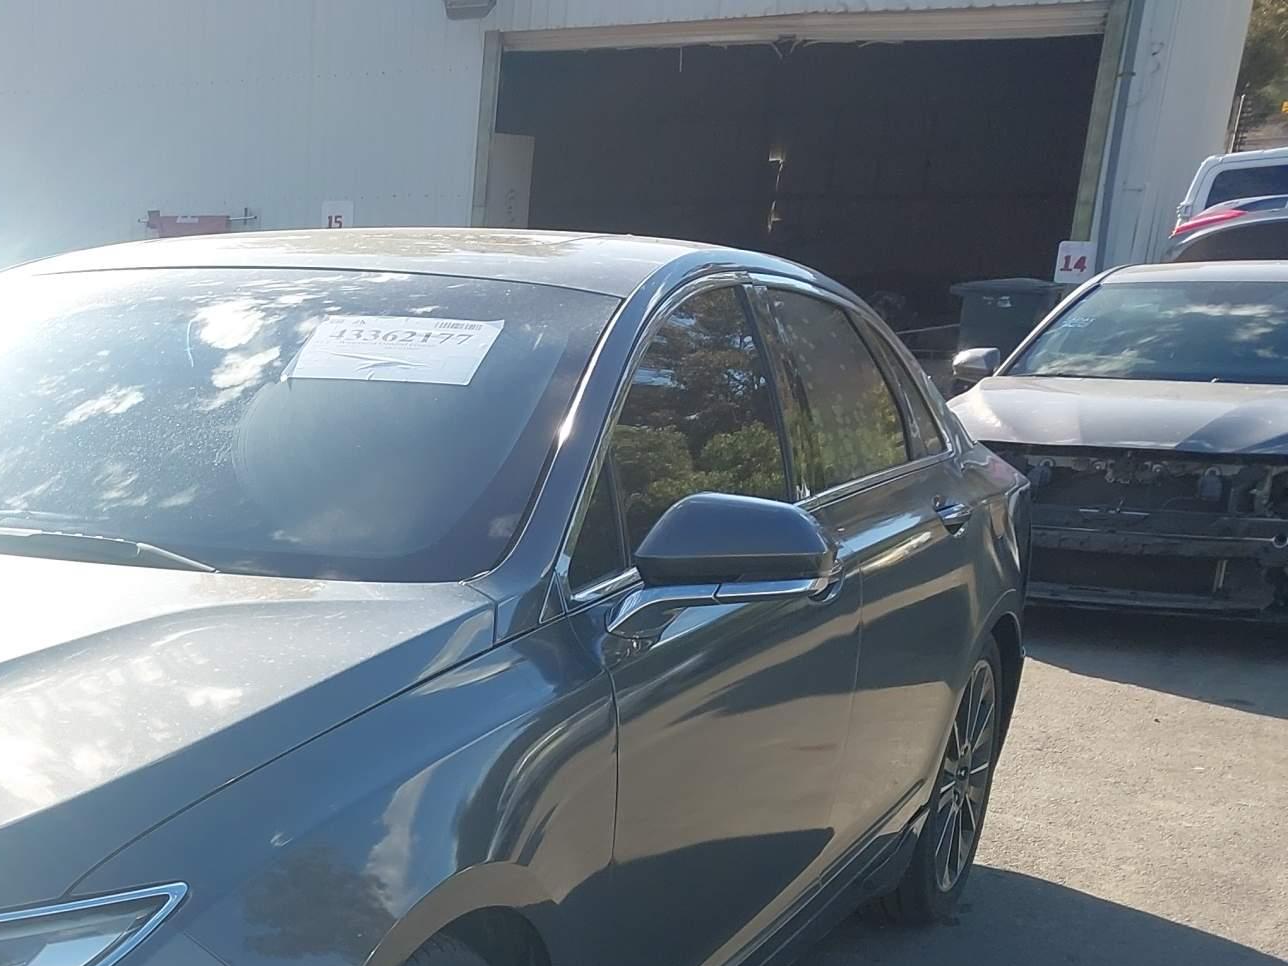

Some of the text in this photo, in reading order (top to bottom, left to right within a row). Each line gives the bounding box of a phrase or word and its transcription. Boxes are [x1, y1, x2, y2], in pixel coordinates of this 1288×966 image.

[327, 215, 343, 229] 15
[1059, 255, 1087, 272] 14
[328, 328, 475, 346] 43362177
